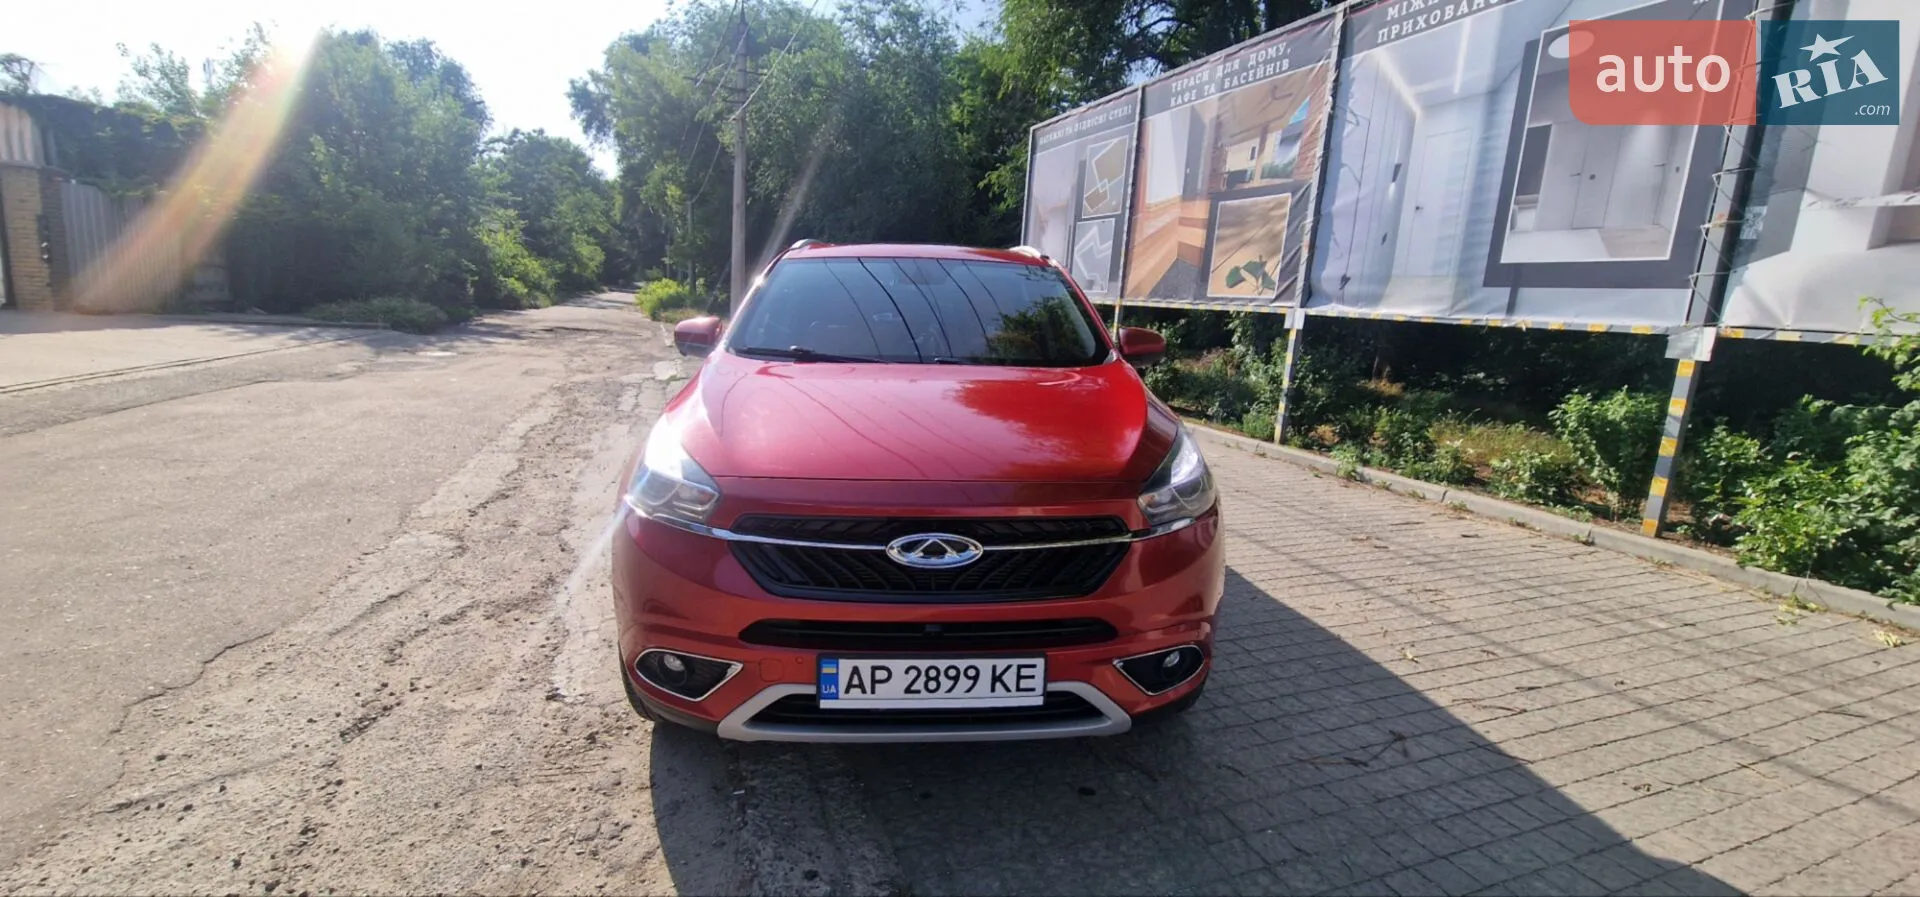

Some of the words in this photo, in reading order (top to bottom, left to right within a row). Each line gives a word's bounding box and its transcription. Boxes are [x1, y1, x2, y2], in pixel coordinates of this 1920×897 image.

[1170, 89, 1197, 107] КАФЕ
[1204, 84, 1216, 97] ТА
[1223, 59, 1290, 89] БАСЕЙНІВ
[1171, 70, 1209, 93] ТЕРАСИ
[1216, 59, 1240, 79] ДЛЯ
[1248, 42, 1292, 69] ДОМУ,
[821, 685, 837, 694] UA
[844, 665, 893, 694] AP
[904, 664, 981, 694] 2899
[990, 663, 1038, 693] KE
